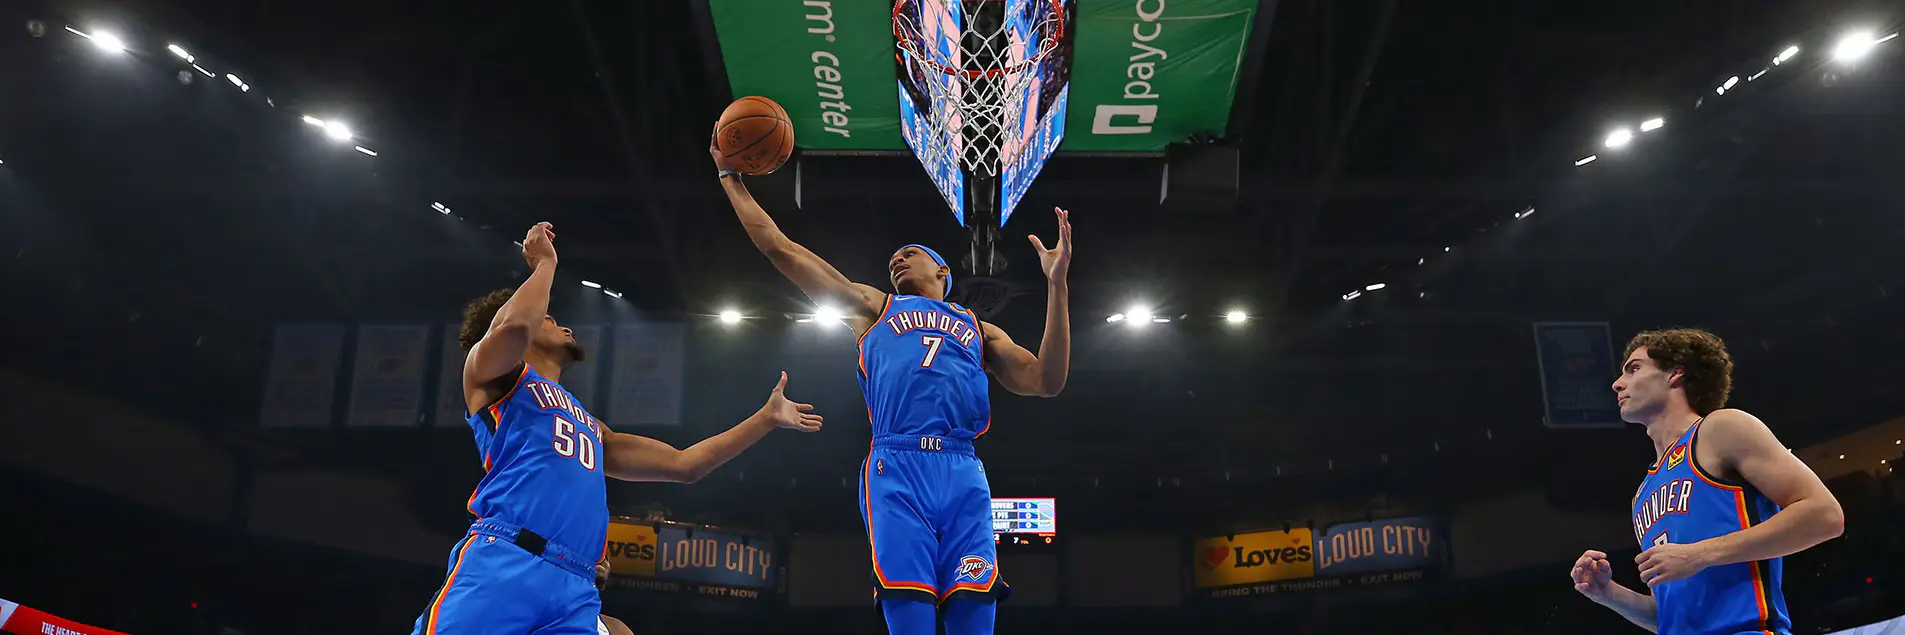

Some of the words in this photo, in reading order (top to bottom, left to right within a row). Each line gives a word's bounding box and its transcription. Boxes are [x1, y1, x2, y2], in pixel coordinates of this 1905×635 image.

[811, 51, 852, 138] center
[886, 310, 976, 349] THUNDER
[920, 335, 944, 368] 7
[552, 413, 596, 472] 50
[920, 435, 942, 451] OKC
[662, 539, 718, 571] LOUD
[725, 541, 771, 580] CITY
[1318, 527, 1375, 570] LOUD
[1382, 525, 1432, 557] CITY
[961, 561, 984, 574] OKC
[699, 585, 727, 596] EXIT
[730, 588, 759, 600] NOW
[41, 621, 55, 635] THE
